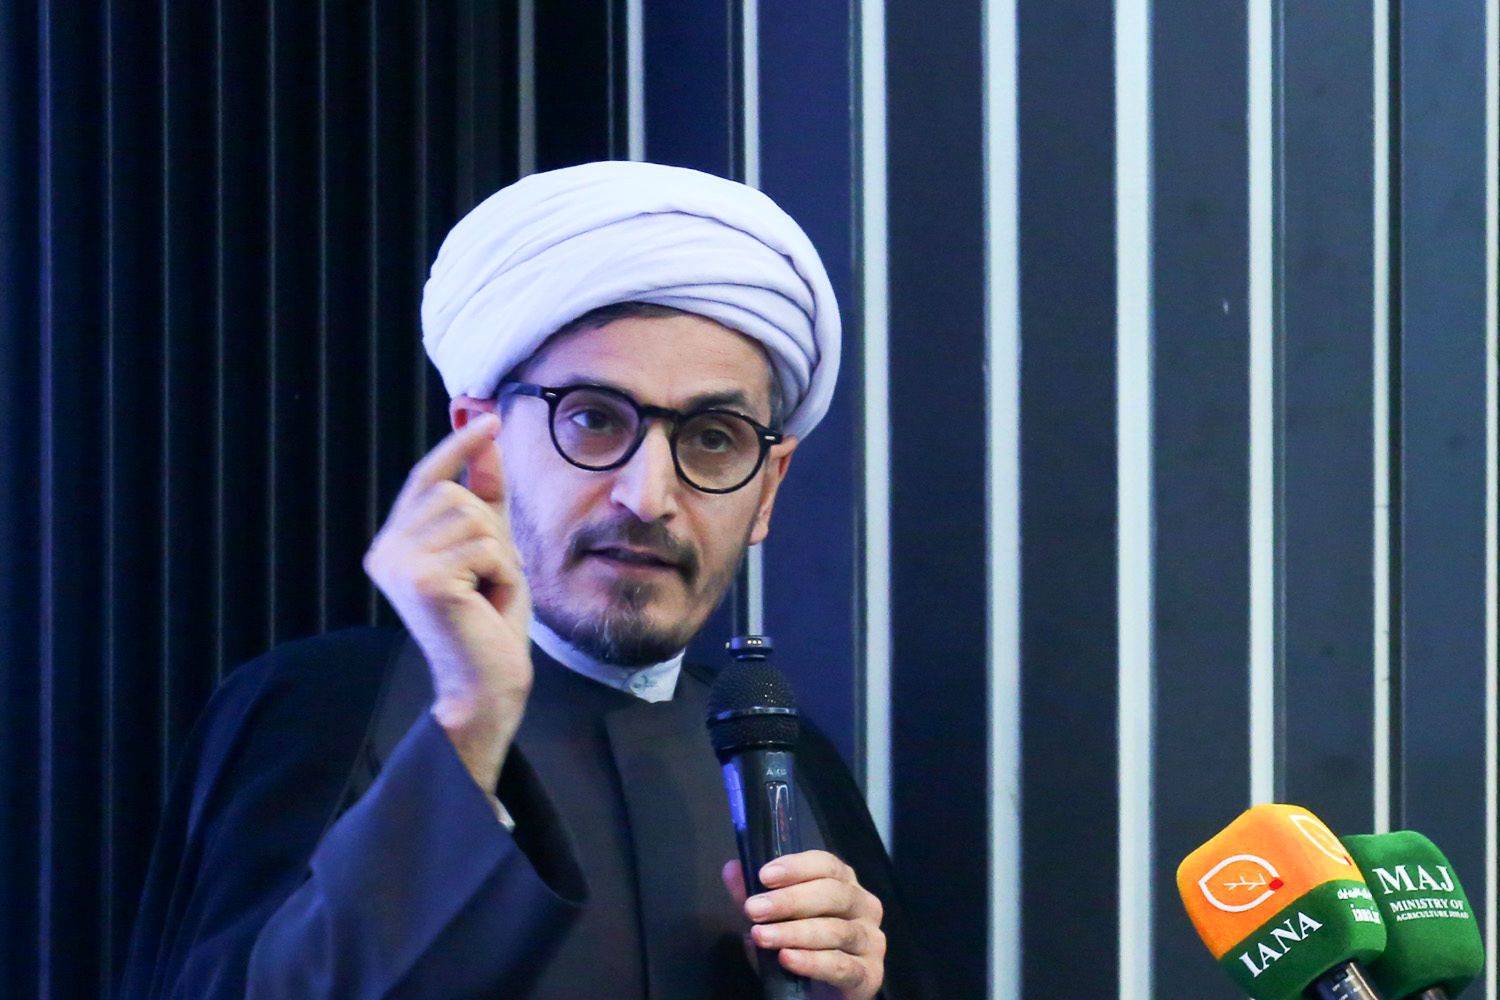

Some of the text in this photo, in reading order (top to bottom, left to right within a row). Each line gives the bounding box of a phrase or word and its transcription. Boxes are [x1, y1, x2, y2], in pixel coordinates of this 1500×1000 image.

[1372, 864, 1455, 895] MAJ
[1389, 898, 1449, 913] MINISTRY
[1238, 911, 1323, 978] IANA
